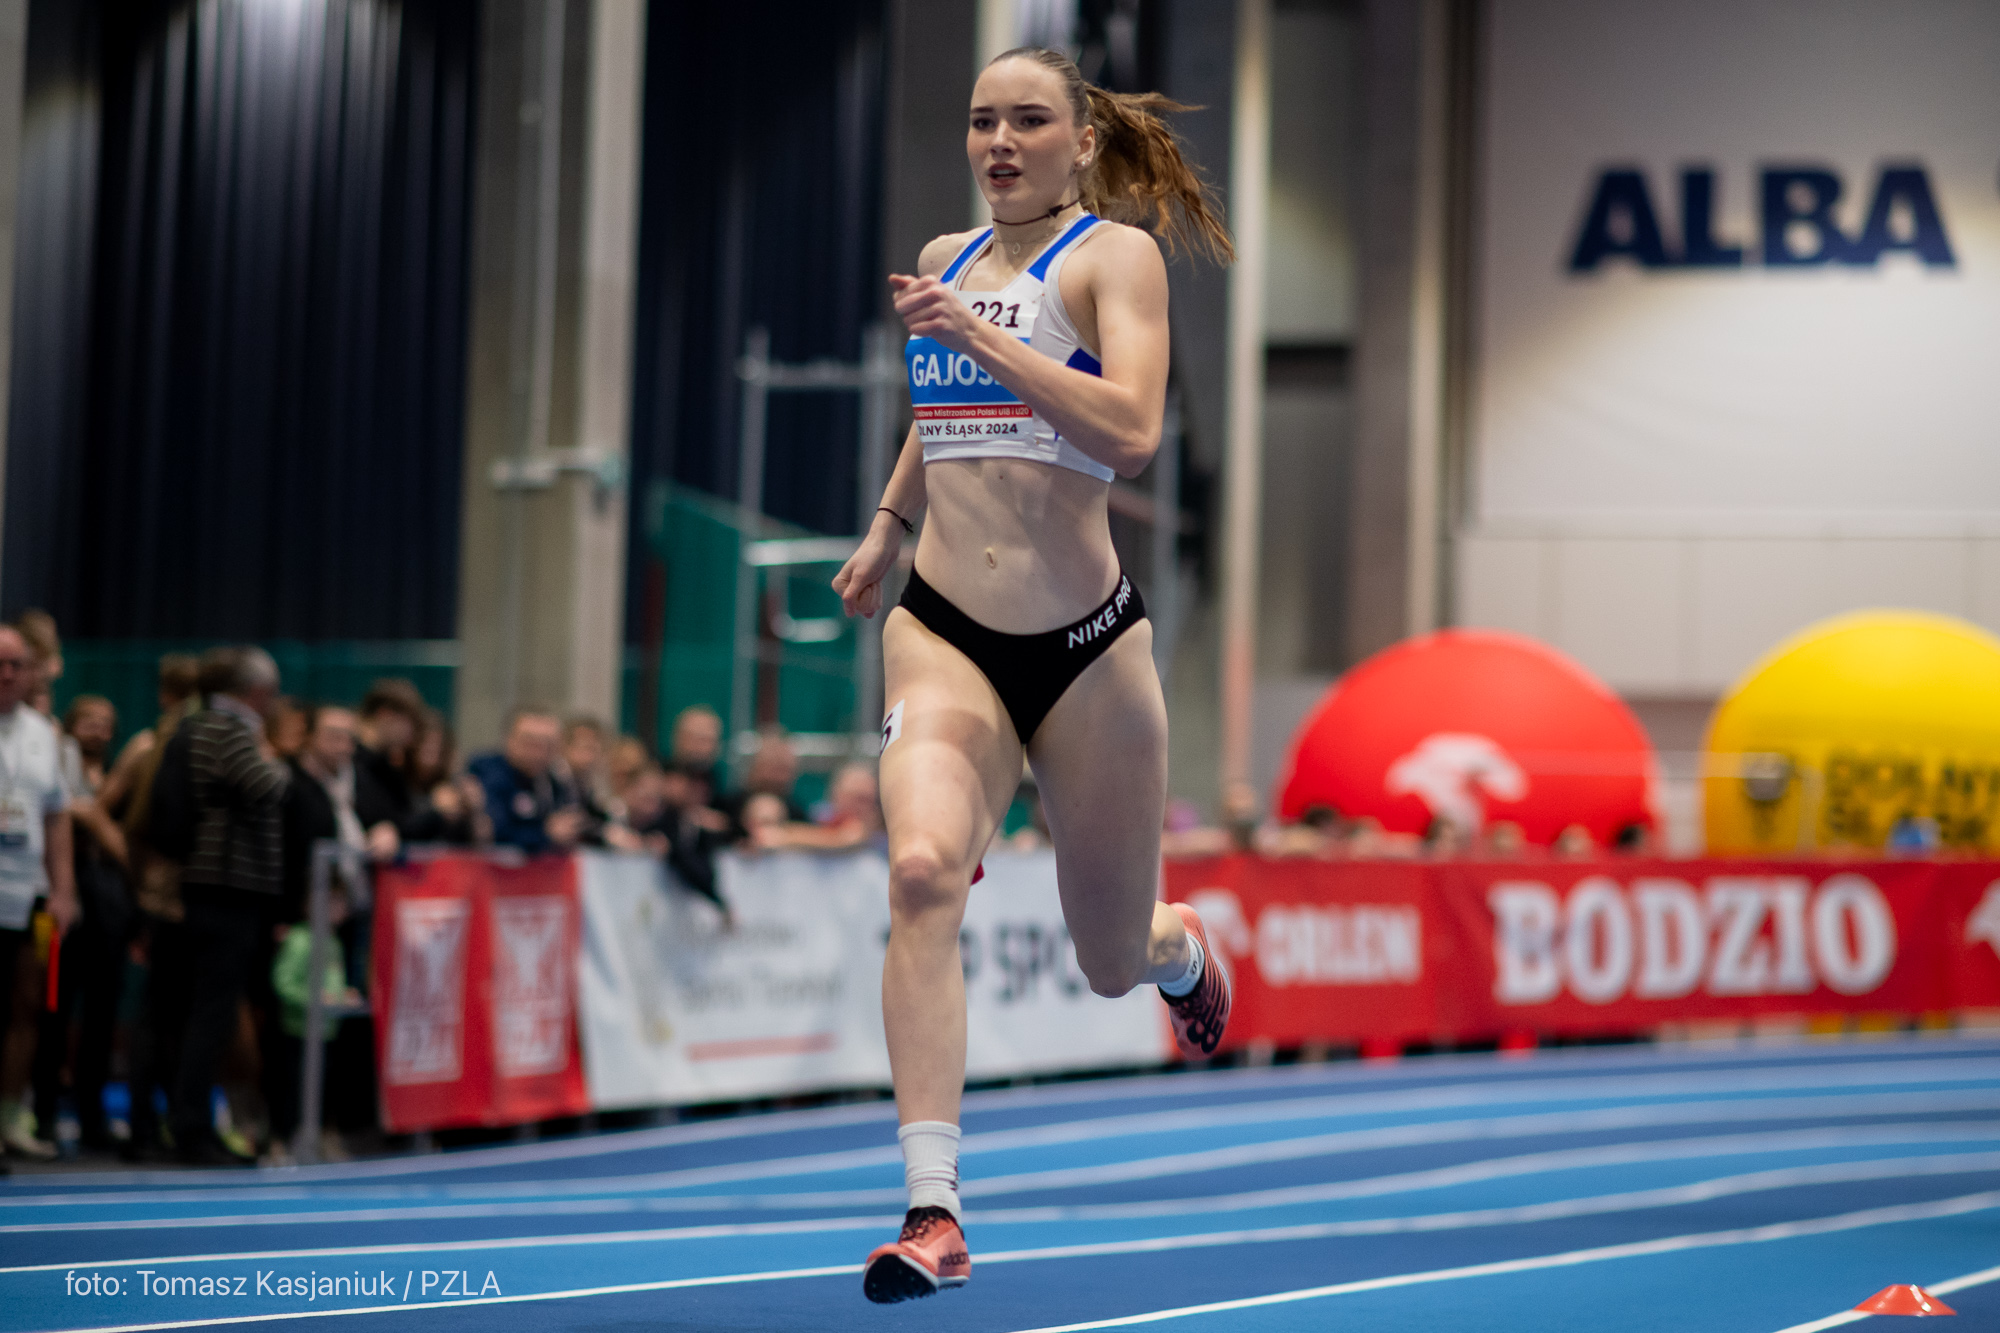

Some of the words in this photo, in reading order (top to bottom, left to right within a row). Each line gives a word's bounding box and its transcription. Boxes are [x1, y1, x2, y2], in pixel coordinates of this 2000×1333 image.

[1567, 161, 1962, 273] ALBA
[971, 301, 1021, 328] 221
[912, 353, 1001, 387] GAJOS
[933, 408, 976, 417] Mistrzostwa
[976, 407, 997, 416] Polski
[998, 407, 1011, 416] U18
[1015, 407, 1029, 416] U20
[945, 421, 983, 438] ŚLĄSK
[986, 423, 1018, 435] 2024
[1068, 604, 1117, 649] NIKE
[1115, 574, 1131, 615] PRO
[1488, 875, 1897, 1004] BODZIO
